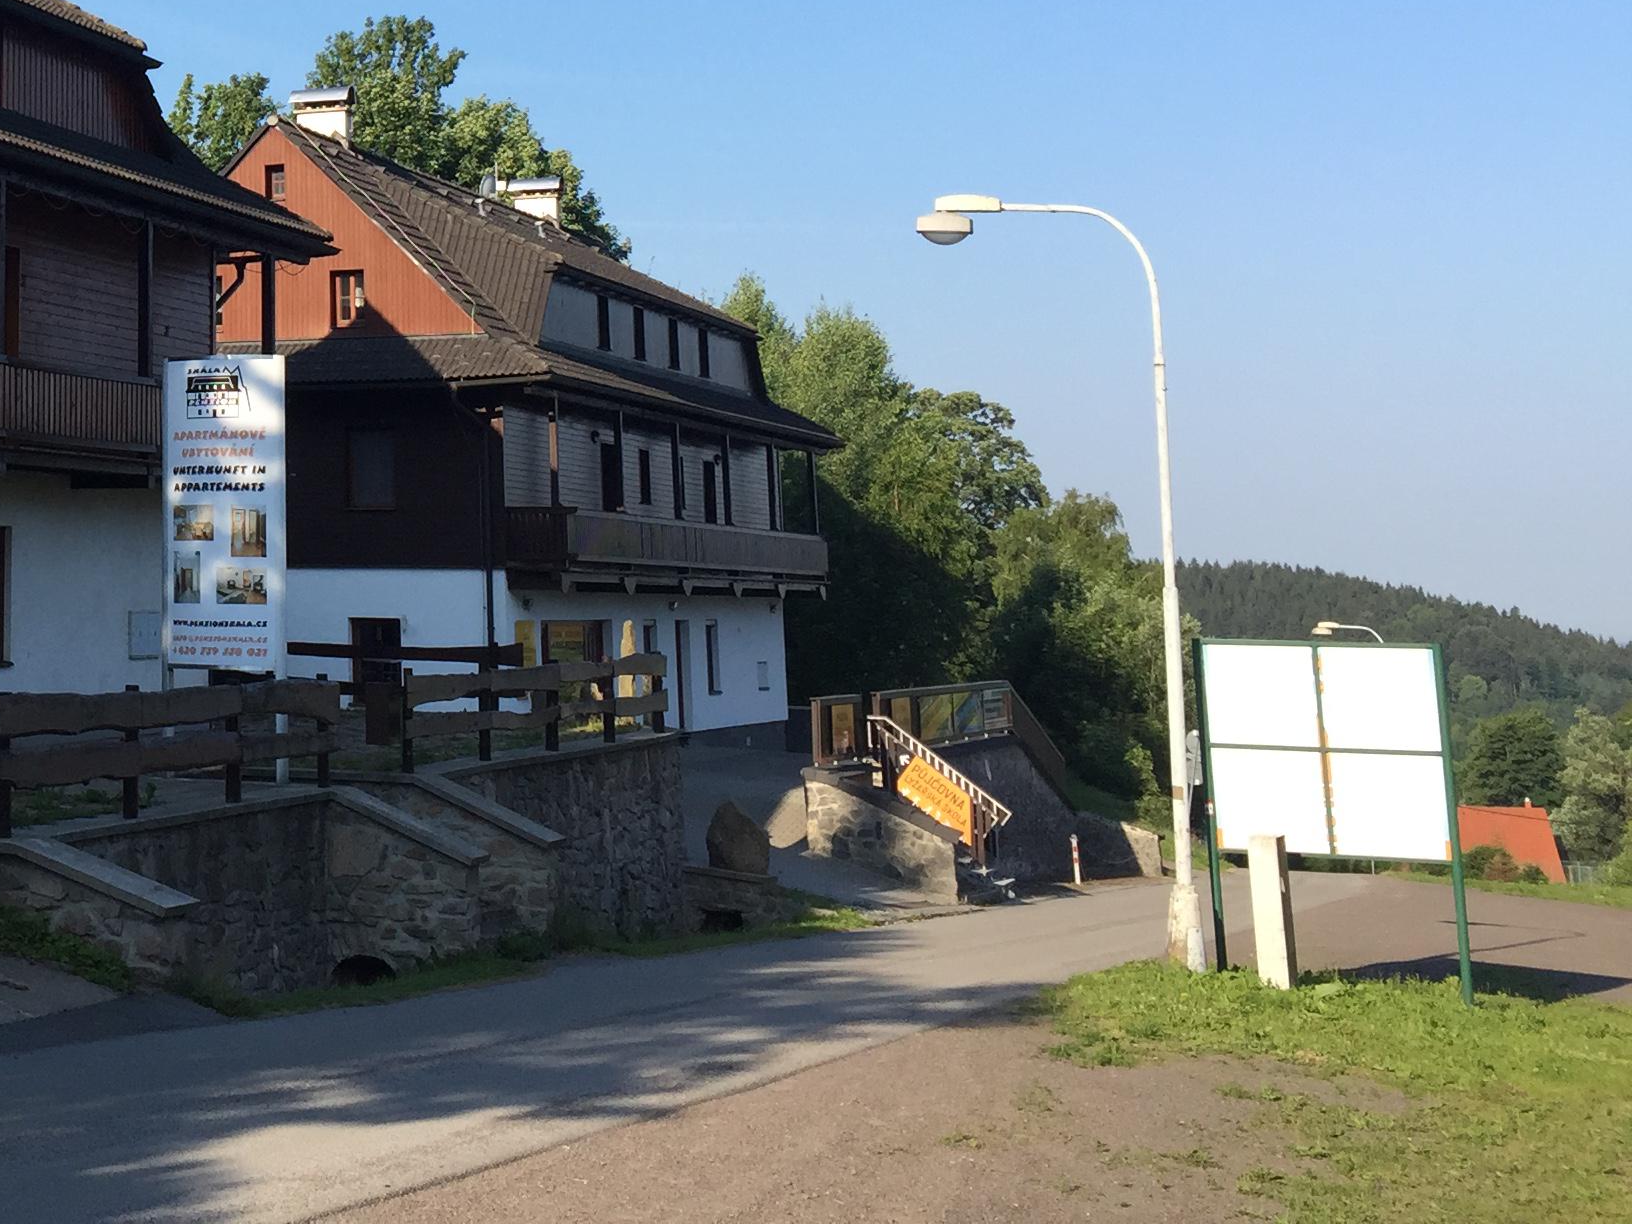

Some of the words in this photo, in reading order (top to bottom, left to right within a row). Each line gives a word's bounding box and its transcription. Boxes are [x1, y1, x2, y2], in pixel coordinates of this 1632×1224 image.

[173, 426, 266, 441] APARTMÁNOVÉ
[181, 443, 256, 457] UBYTOVÁNÍ
[173, 465, 247, 476] UNTERKUNFT
[252, 465, 267, 475] IN
[174, 482, 266, 493] APPARTEMENTS
